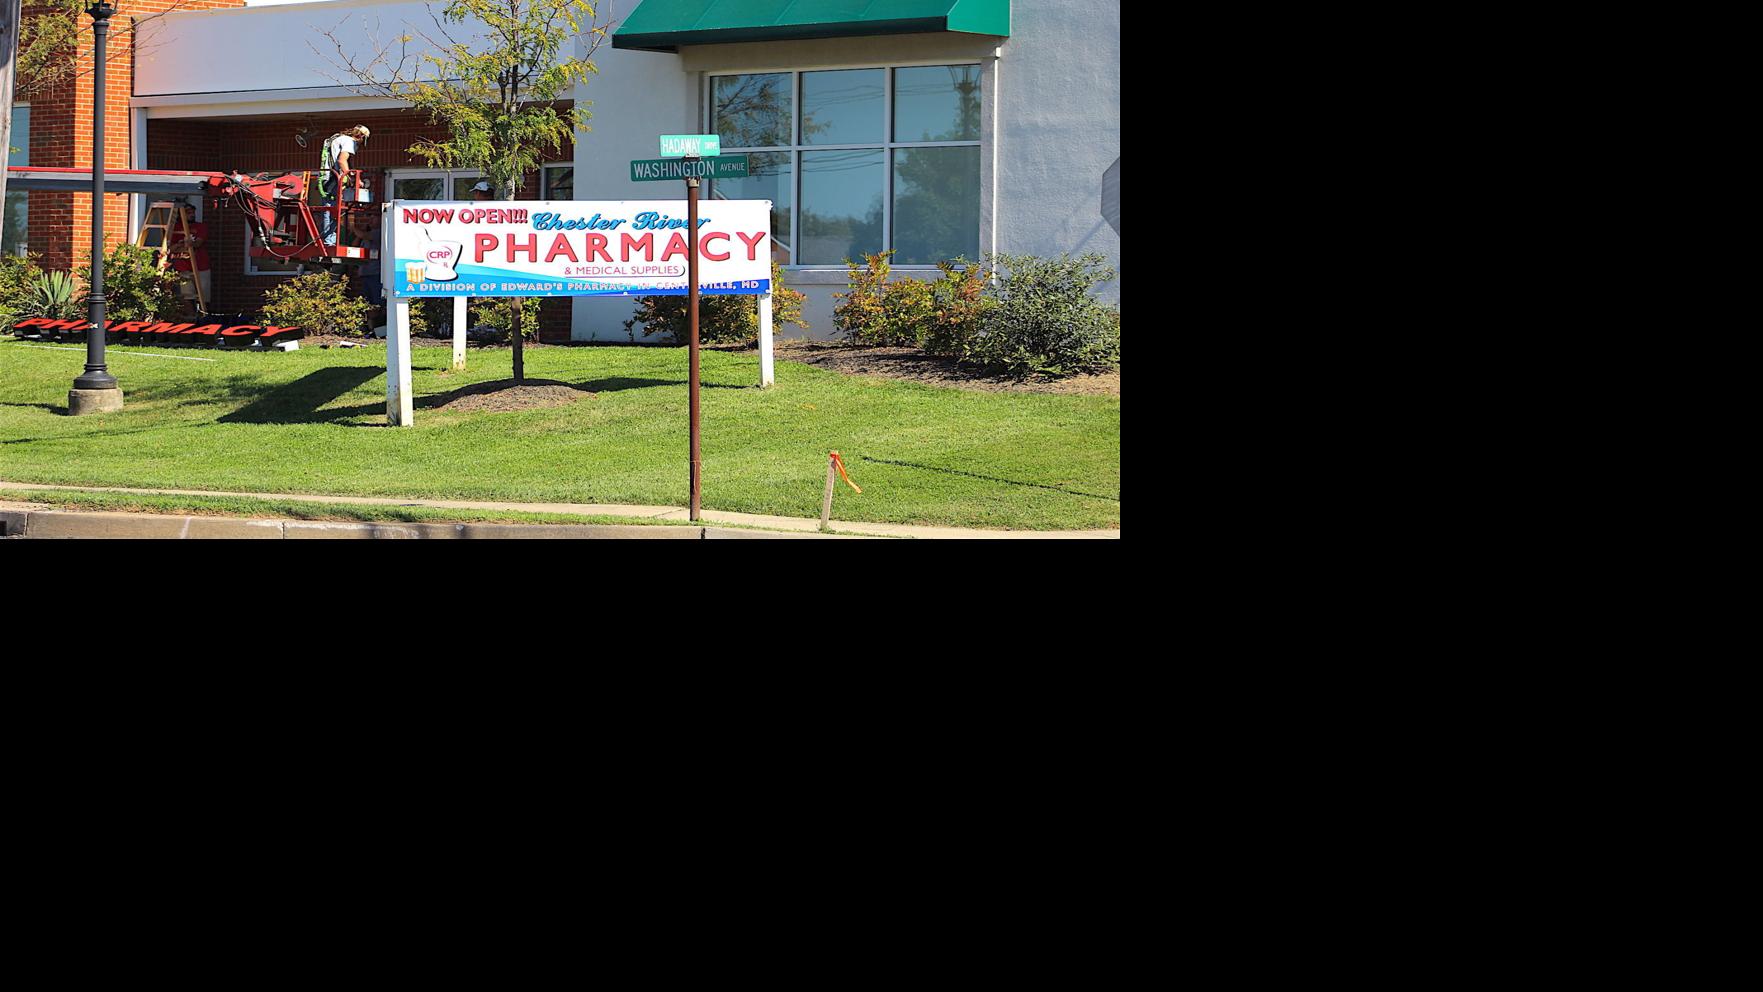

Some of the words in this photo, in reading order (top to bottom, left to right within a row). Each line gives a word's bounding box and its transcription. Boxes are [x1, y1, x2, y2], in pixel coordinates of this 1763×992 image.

[662, 138, 701, 153] HADAWAY
[633, 160, 715, 178] WASHINGTON
[720, 162, 745, 172] AVENUE
[403, 208, 455, 224] NOW
[458, 208, 528, 224] OPEN!!!
[531, 212, 627, 230] Chester
[474, 231, 767, 263] PHARMACY
[429, 251, 451, 259] CRP
[564, 266, 572, 275] &
[576, 266, 627, 275] MEDICAL
[631, 265, 679, 274] SUPPLIES
[406, 283, 415, 292] A
[419, 283, 476, 292] DIVISION
[479, 283, 497, 292] OF
[501, 282, 563, 291] EDWARD'S
[567, 282, 631, 291] PHARMACY
[637, 282, 651, 290] IN
[656, 281, 736, 290] CENTVILLE,
[741, 280, 760, 289] MD
